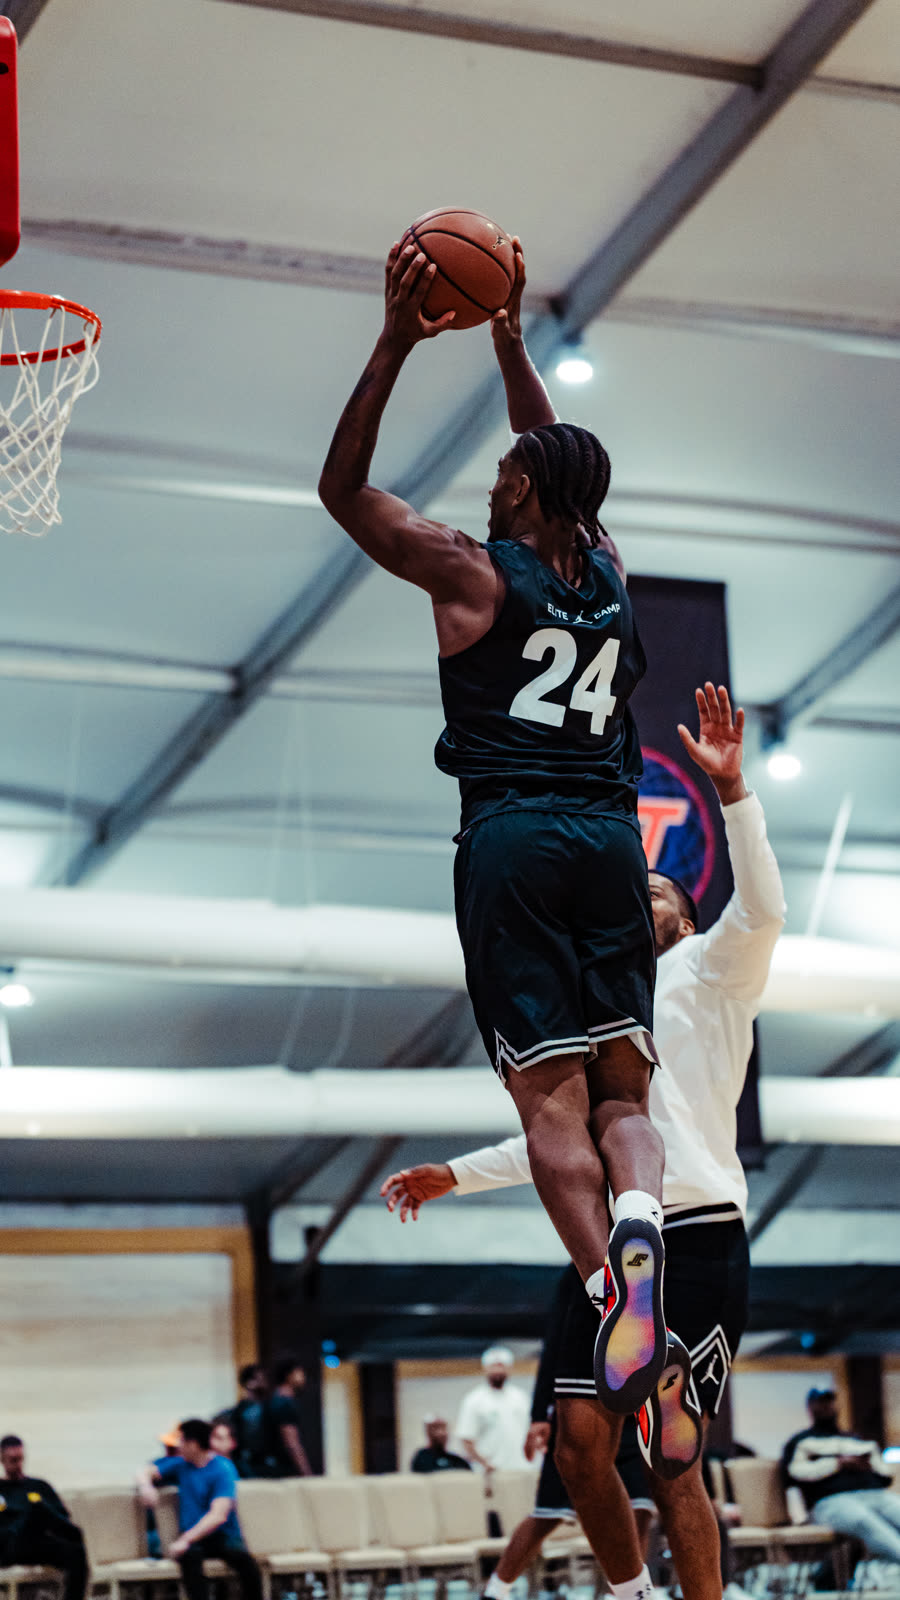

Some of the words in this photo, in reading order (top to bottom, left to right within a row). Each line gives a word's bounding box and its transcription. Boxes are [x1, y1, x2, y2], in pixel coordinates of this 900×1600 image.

[547, 602, 569, 621] ELITE
[593, 603, 621, 620] CAMP
[509, 627, 621, 736] 24
